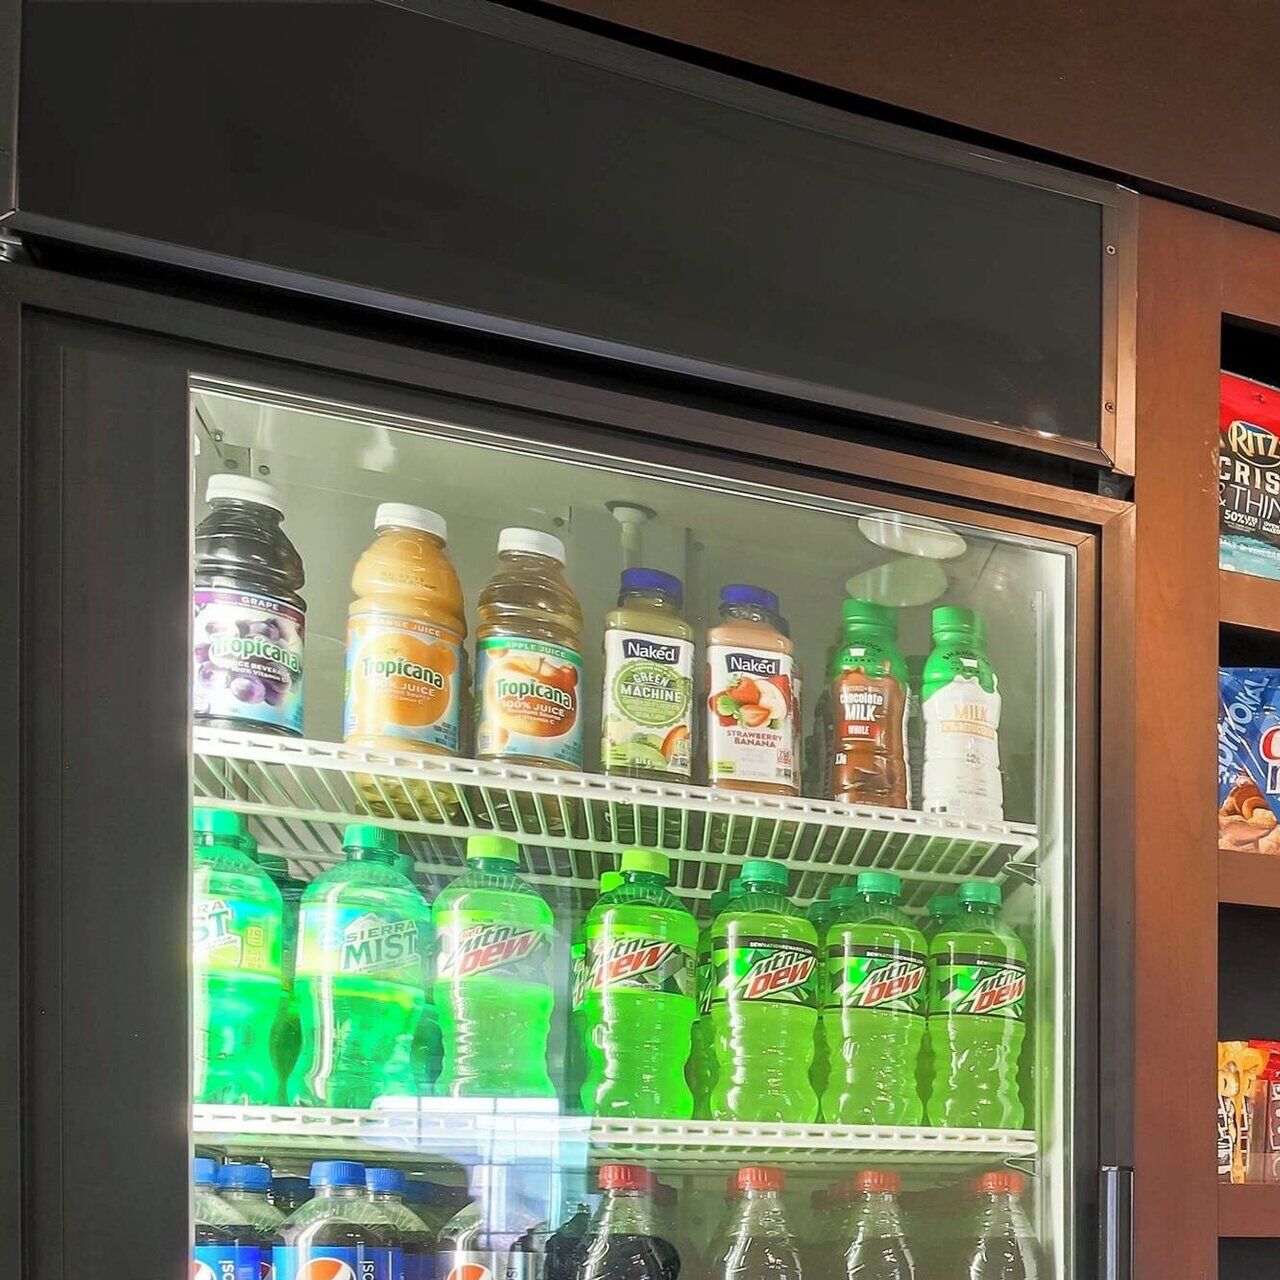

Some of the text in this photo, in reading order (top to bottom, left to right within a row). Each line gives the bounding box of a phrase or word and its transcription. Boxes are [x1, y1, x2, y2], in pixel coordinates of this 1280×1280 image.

[1230, 420, 1280, 460] RITZ
[1224, 509, 1247, 525] 50%
[240, 596, 280, 611] GRAPE
[412, 623, 442, 637] JUICE
[211, 635, 300, 672] Tropicana
[507, 641, 567, 659] APPLE JUICE
[627, 641, 676, 662] Naked
[362, 657, 444, 689] Tropicana
[730, 658, 776, 675] Naked
[633, 673, 670, 687] GREEN
[496, 678, 572, 709] Tropicana
[620, 684, 682, 703] MACHINE
[839, 691, 884, 707] chocolate
[533, 702, 565, 717] JUICE
[844, 704, 876, 722] MILK
[726, 729, 783, 742] STRAWBERRY
[848, 724, 870, 735] WHOLE
[734, 736, 777, 749] BANANA
[346, 919, 417, 943] SIERRA
[342, 931, 418, 970] MIST
